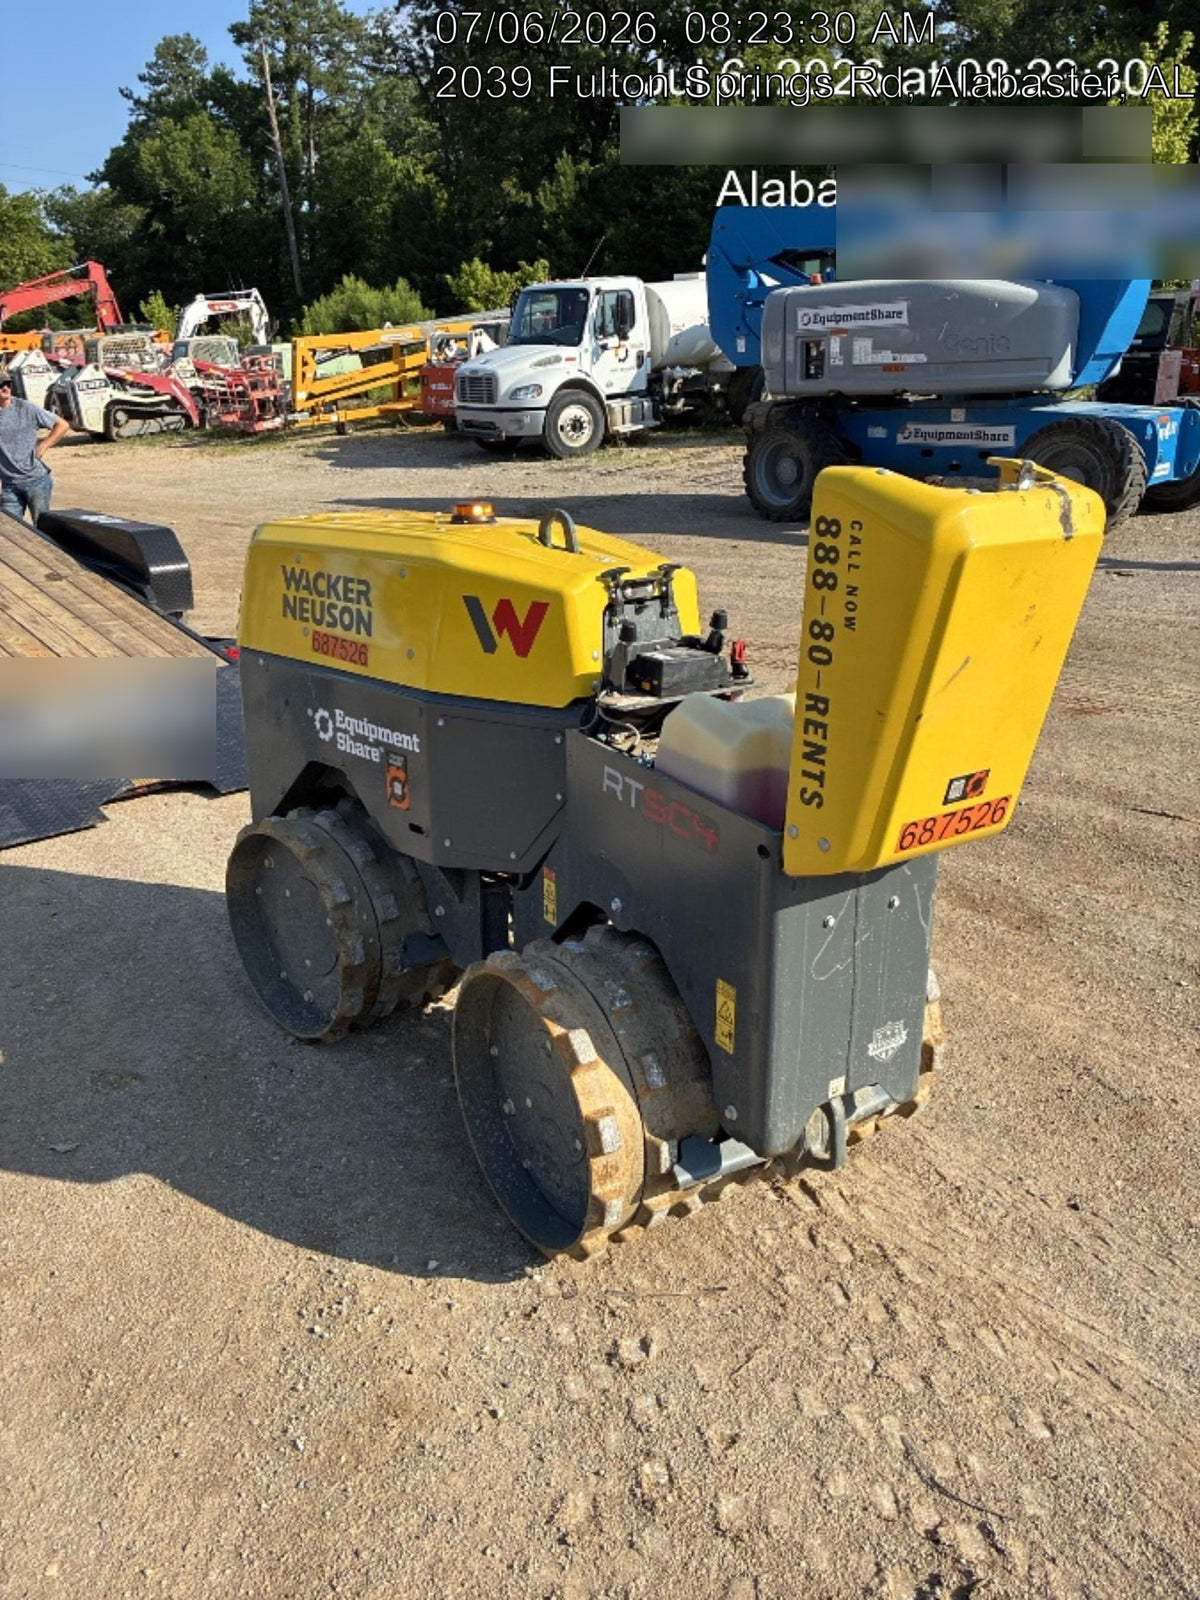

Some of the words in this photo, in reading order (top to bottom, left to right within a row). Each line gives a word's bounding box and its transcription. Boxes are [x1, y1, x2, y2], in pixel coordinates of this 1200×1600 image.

[913, 428, 1010, 442] EquipmentShare
[846, 520, 863, 573] CALL
[281, 565, 373, 607] WACKER
[843, 584, 859, 632] NOW
[282, 593, 373, 637] NEUSON
[312, 629, 369, 667] 687526
[800, 515, 842, 810] 888-80-RENTS
[334, 708, 421, 753] Equipment
[899, 797, 1009, 850] 687526
